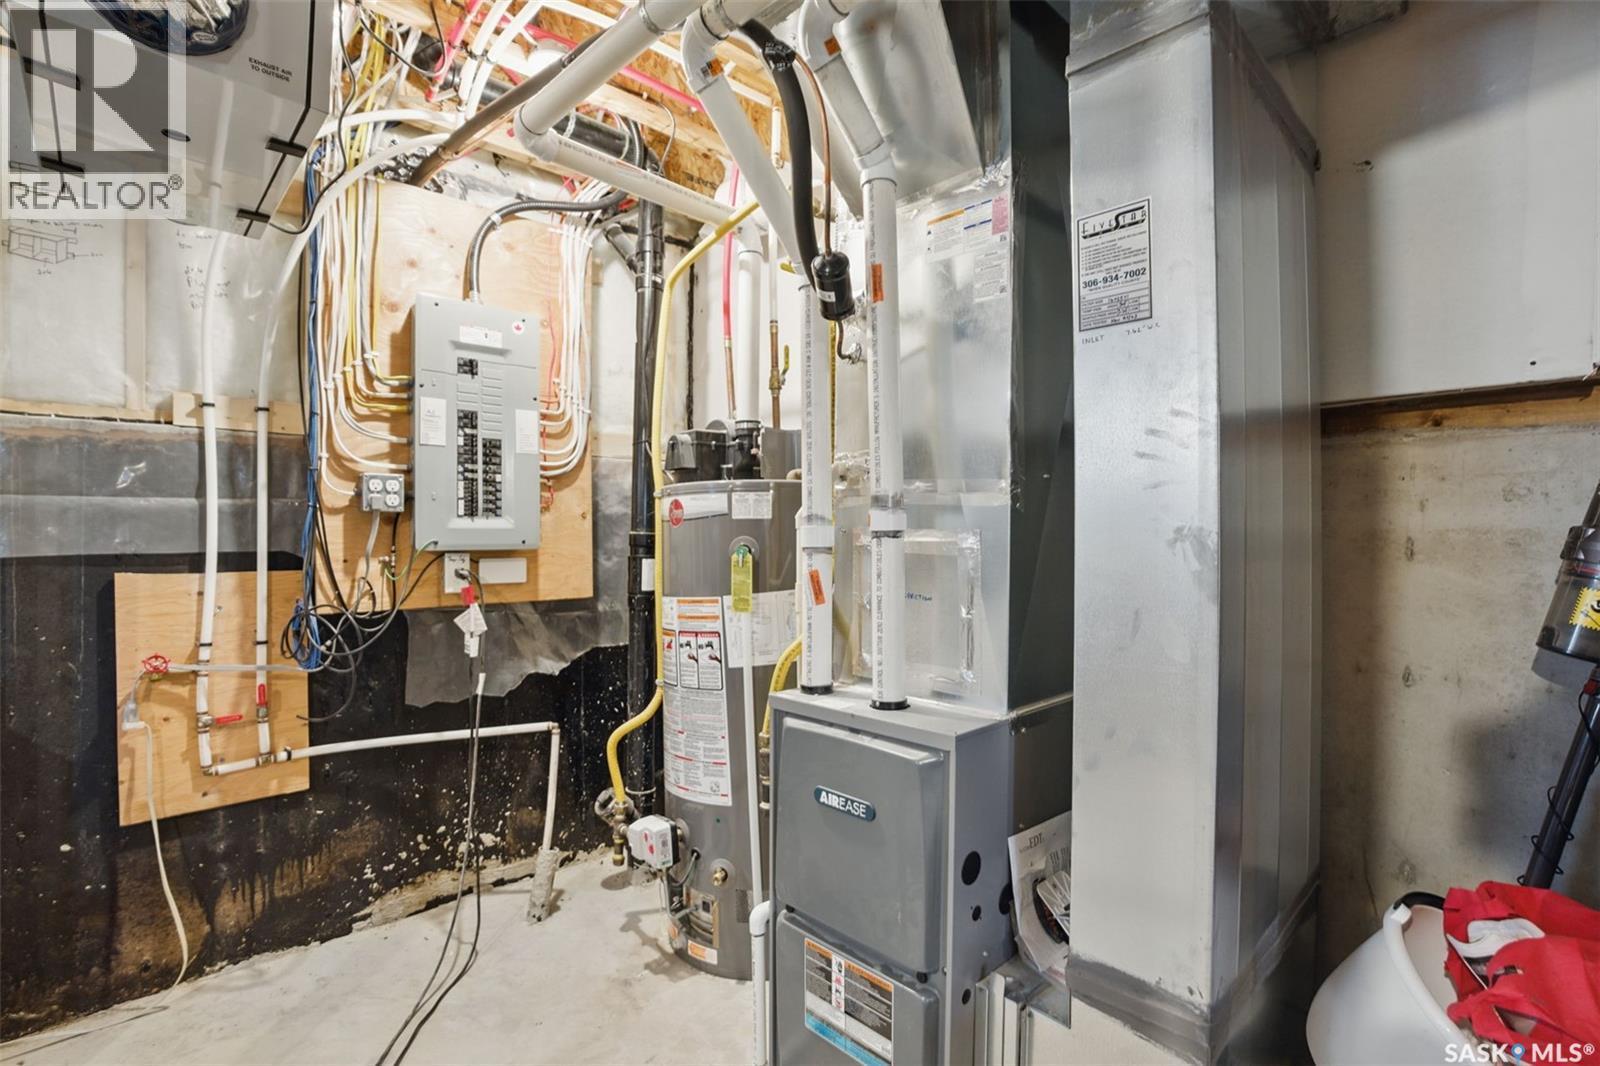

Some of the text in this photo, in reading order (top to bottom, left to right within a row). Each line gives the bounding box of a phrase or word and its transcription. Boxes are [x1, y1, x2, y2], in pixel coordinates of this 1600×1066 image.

[249, 57, 279, 71] EXHAUST
[261, 68, 290, 82] OUTSIDE
[1082, 267, 1146, 289] 306-934-7002
[1082, 335, 1104, 344] INLET
[820, 791, 866, 818] AIREASE
